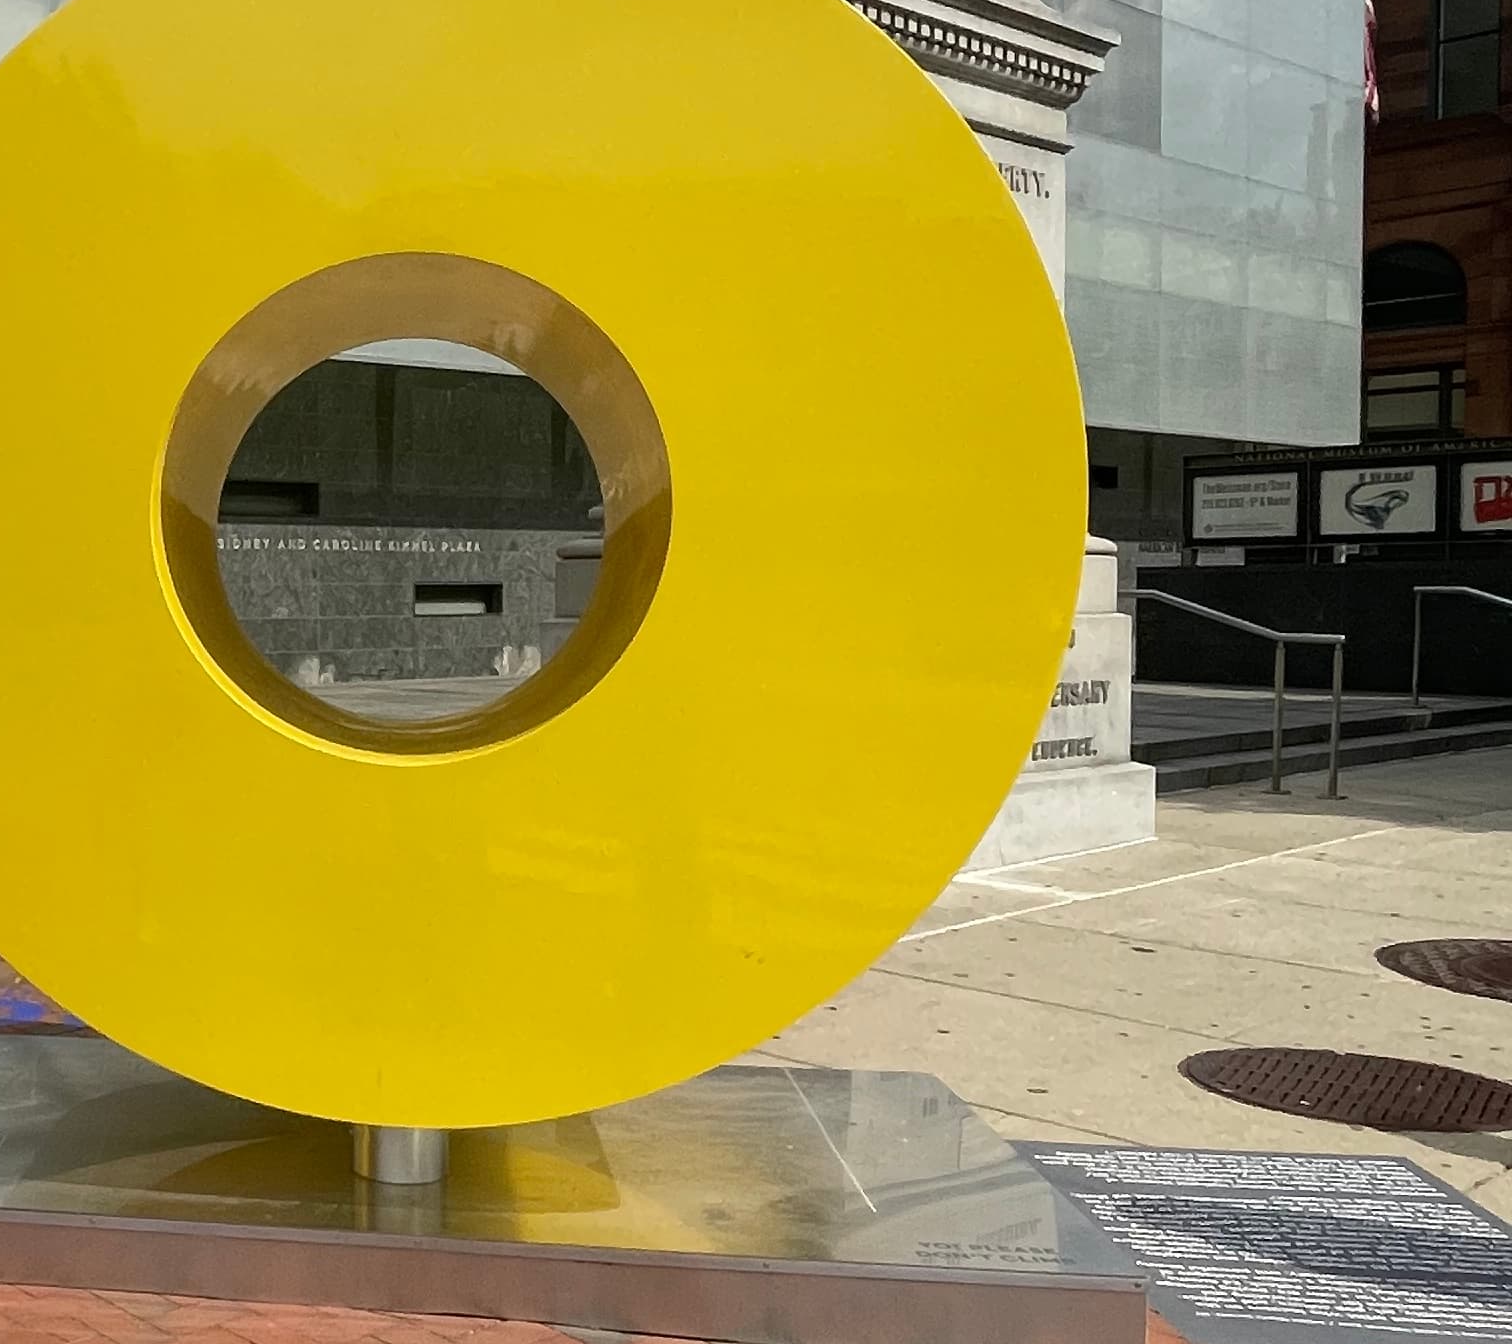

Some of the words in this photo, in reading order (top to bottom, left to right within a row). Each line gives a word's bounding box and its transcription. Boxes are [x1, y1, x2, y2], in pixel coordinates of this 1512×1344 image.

[216, 538, 270, 550] SIDNEY
[277, 538, 306, 550] AND
[313, 539, 382, 552] CAROLINE
[388, 540, 436, 553] KIMMEL
[441, 540, 482, 553] PLAZA
